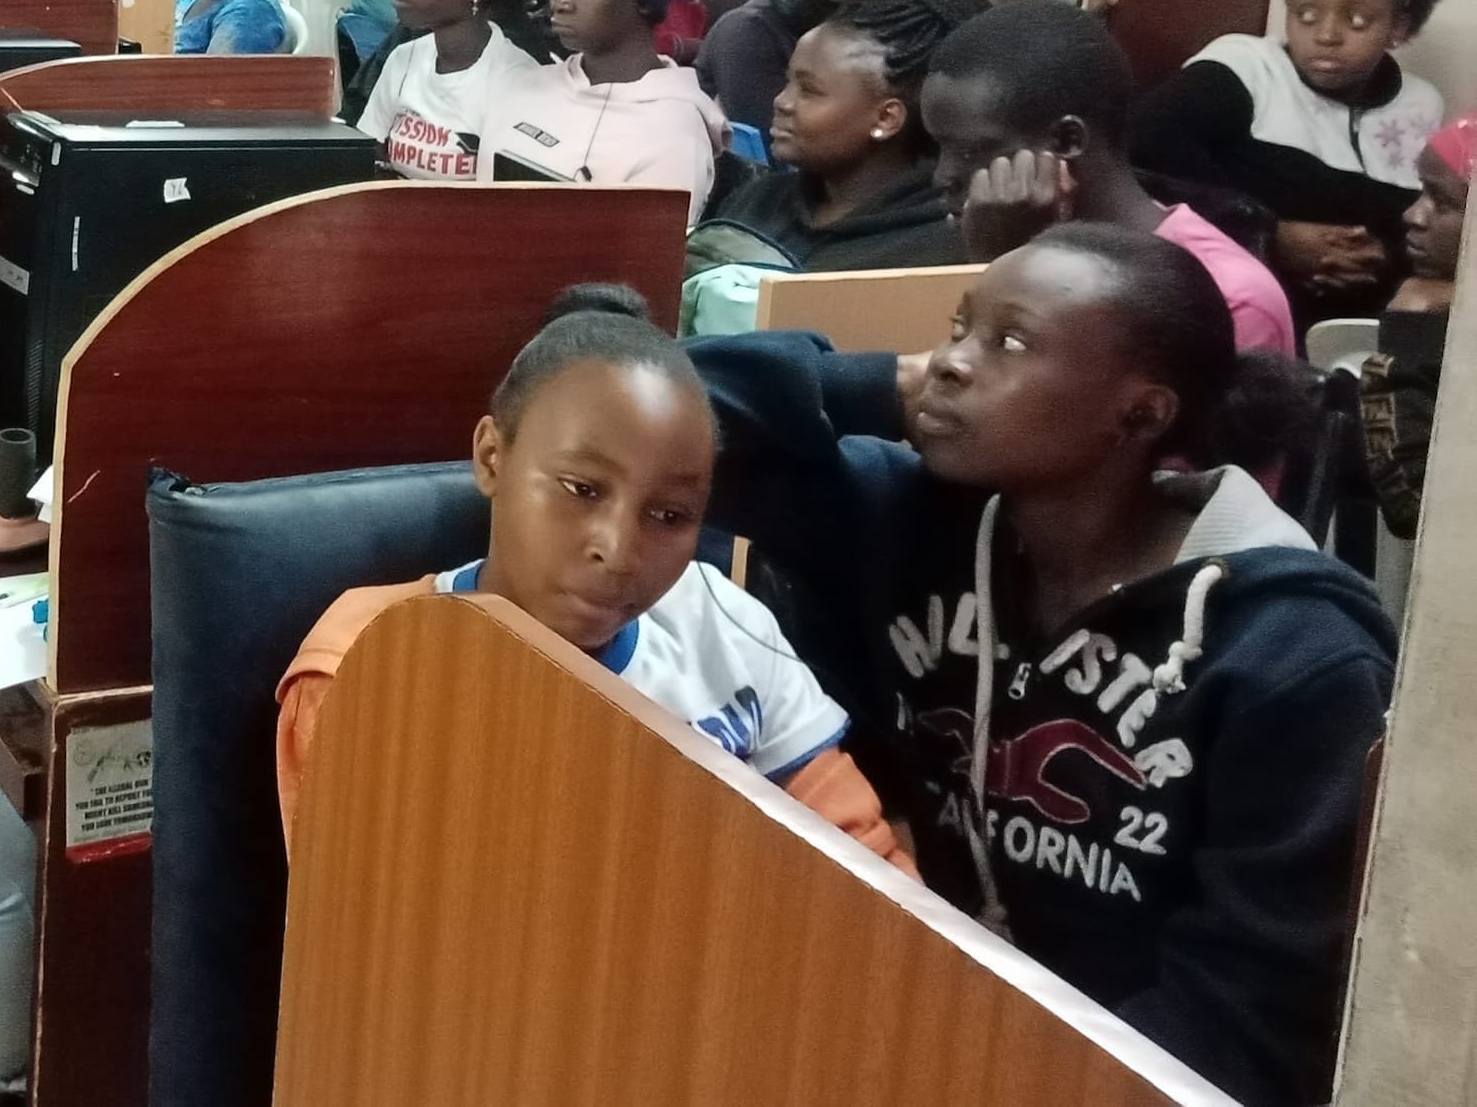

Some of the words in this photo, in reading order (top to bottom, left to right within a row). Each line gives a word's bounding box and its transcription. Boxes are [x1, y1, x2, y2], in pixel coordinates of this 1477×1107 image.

[388, 139, 477, 176] MPLETE
[925, 780, 1142, 902] AFORNIA
[1114, 804, 1168, 856] 22
